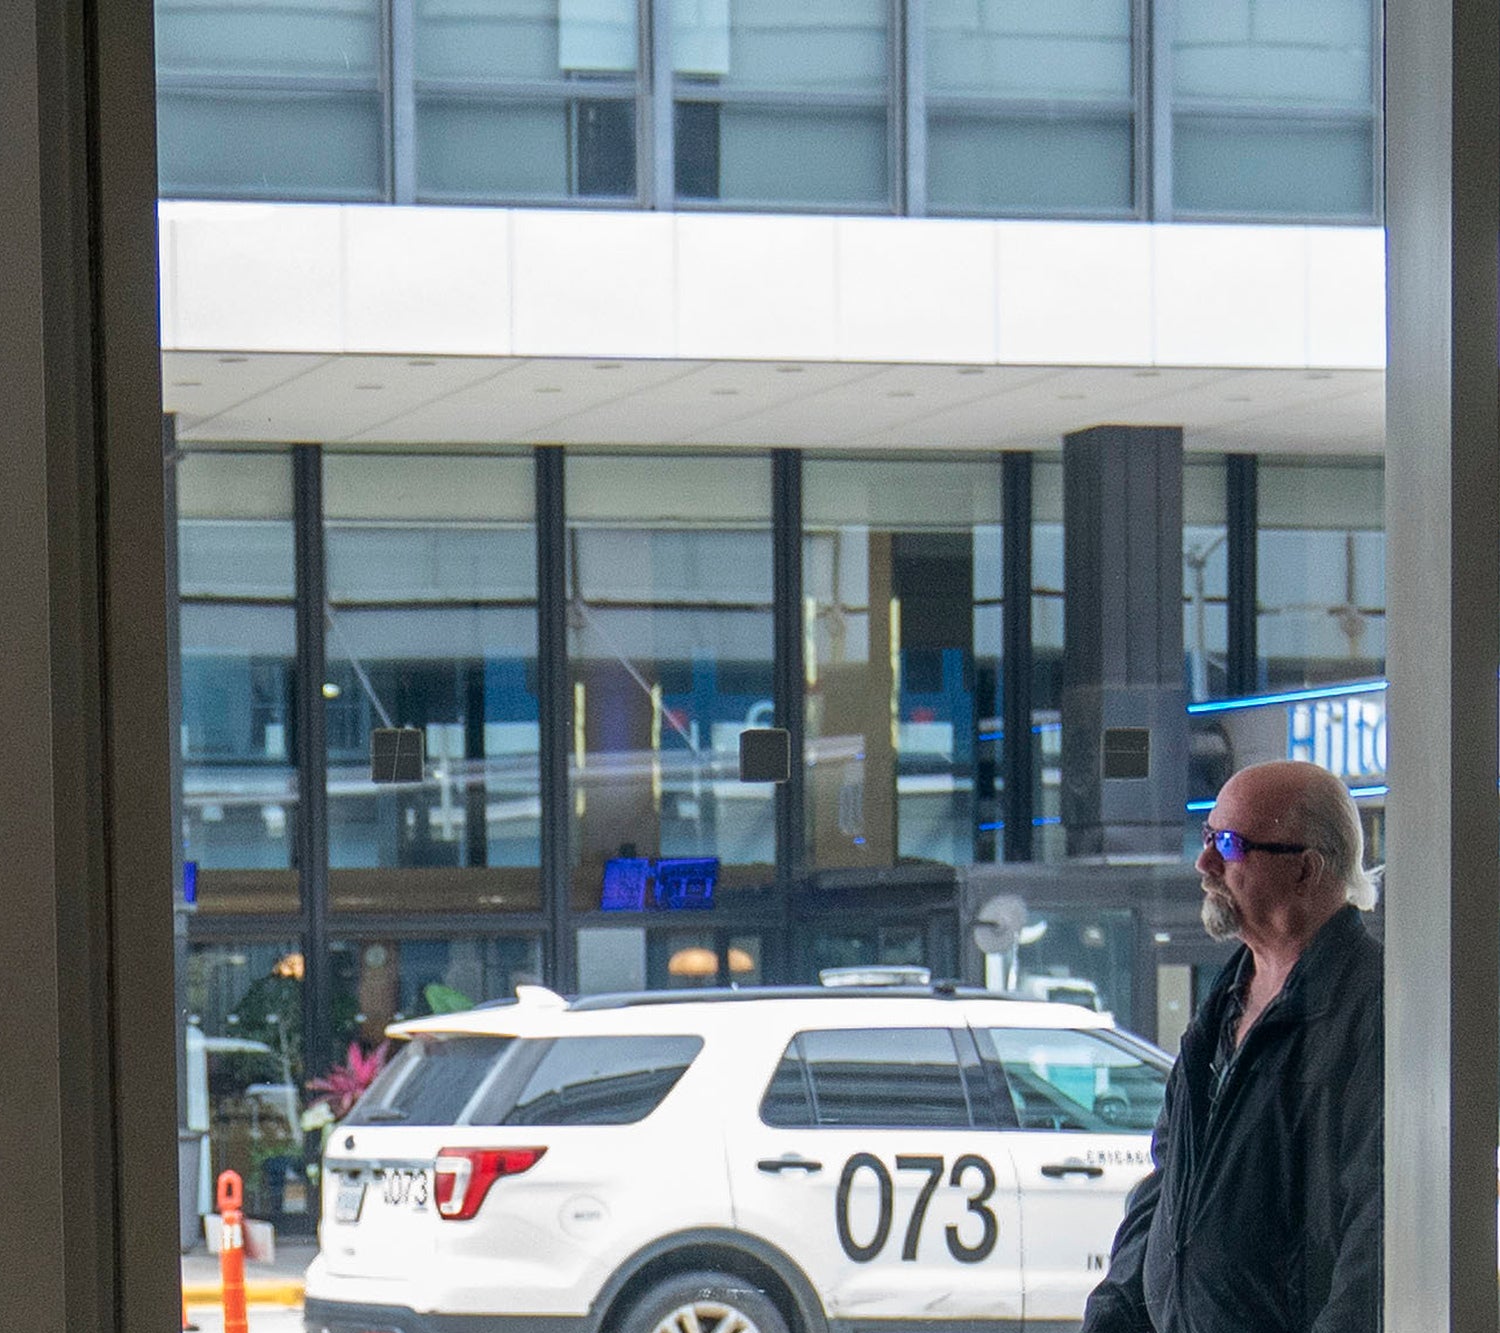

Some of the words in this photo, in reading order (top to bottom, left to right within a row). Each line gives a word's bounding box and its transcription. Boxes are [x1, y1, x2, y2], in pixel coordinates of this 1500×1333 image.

[1287, 699, 1387, 776] Hilto
[1086, 1150, 1151, 1165] CHICAG
[835, 1152, 999, 1264] 073
